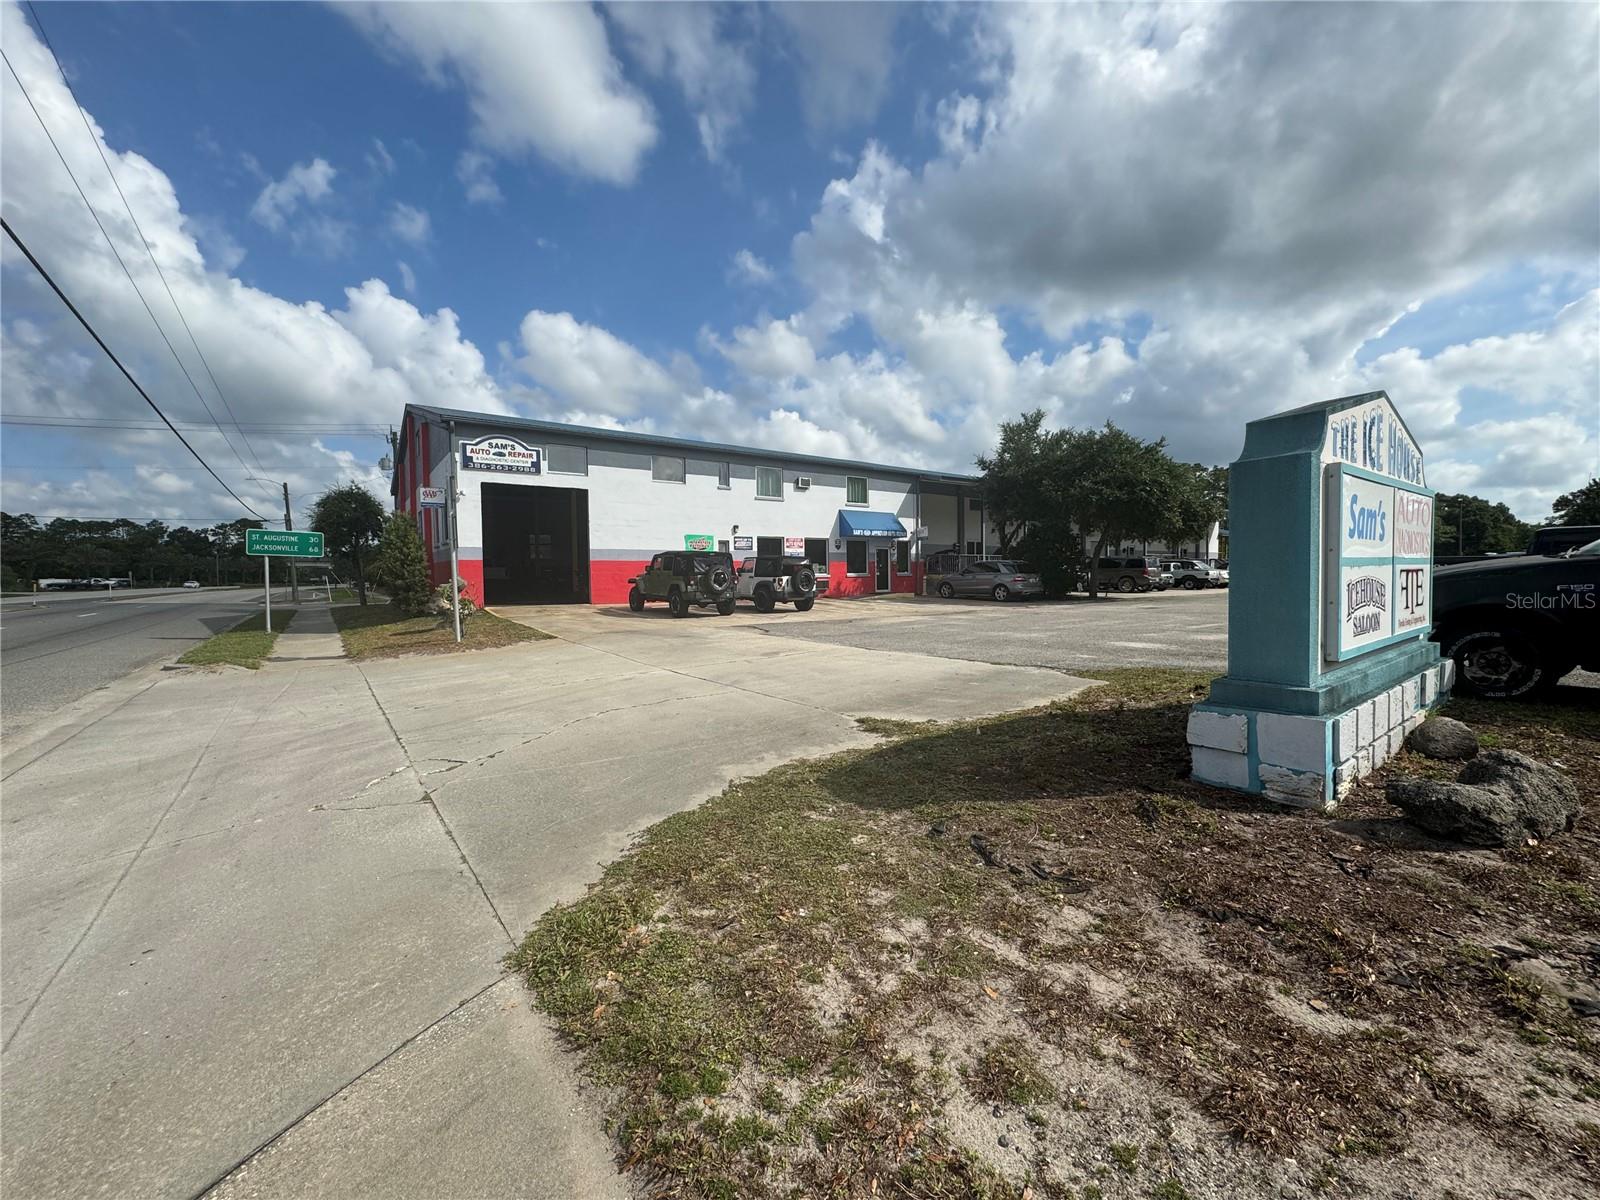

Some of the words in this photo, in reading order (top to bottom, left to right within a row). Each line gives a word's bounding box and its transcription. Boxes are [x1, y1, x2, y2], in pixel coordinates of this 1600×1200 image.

[487, 442, 516, 451] SAM'S
[507, 451, 534, 459] REPAIR
[1331, 414, 1357, 463] THE
[1363, 404, 1383, 472] ICE
[1388, 413, 1421, 485] HOUSE
[1348, 494, 1386, 542] Sam's
[1396, 496, 1431, 528] AUTO
[252, 544, 299, 552] JACKSONVILLE
[263, 534, 299, 542] AUGUSTINE
[1346, 576, 1386, 622] ICEHOUSE
[1353, 612, 1381, 637] SALOON
